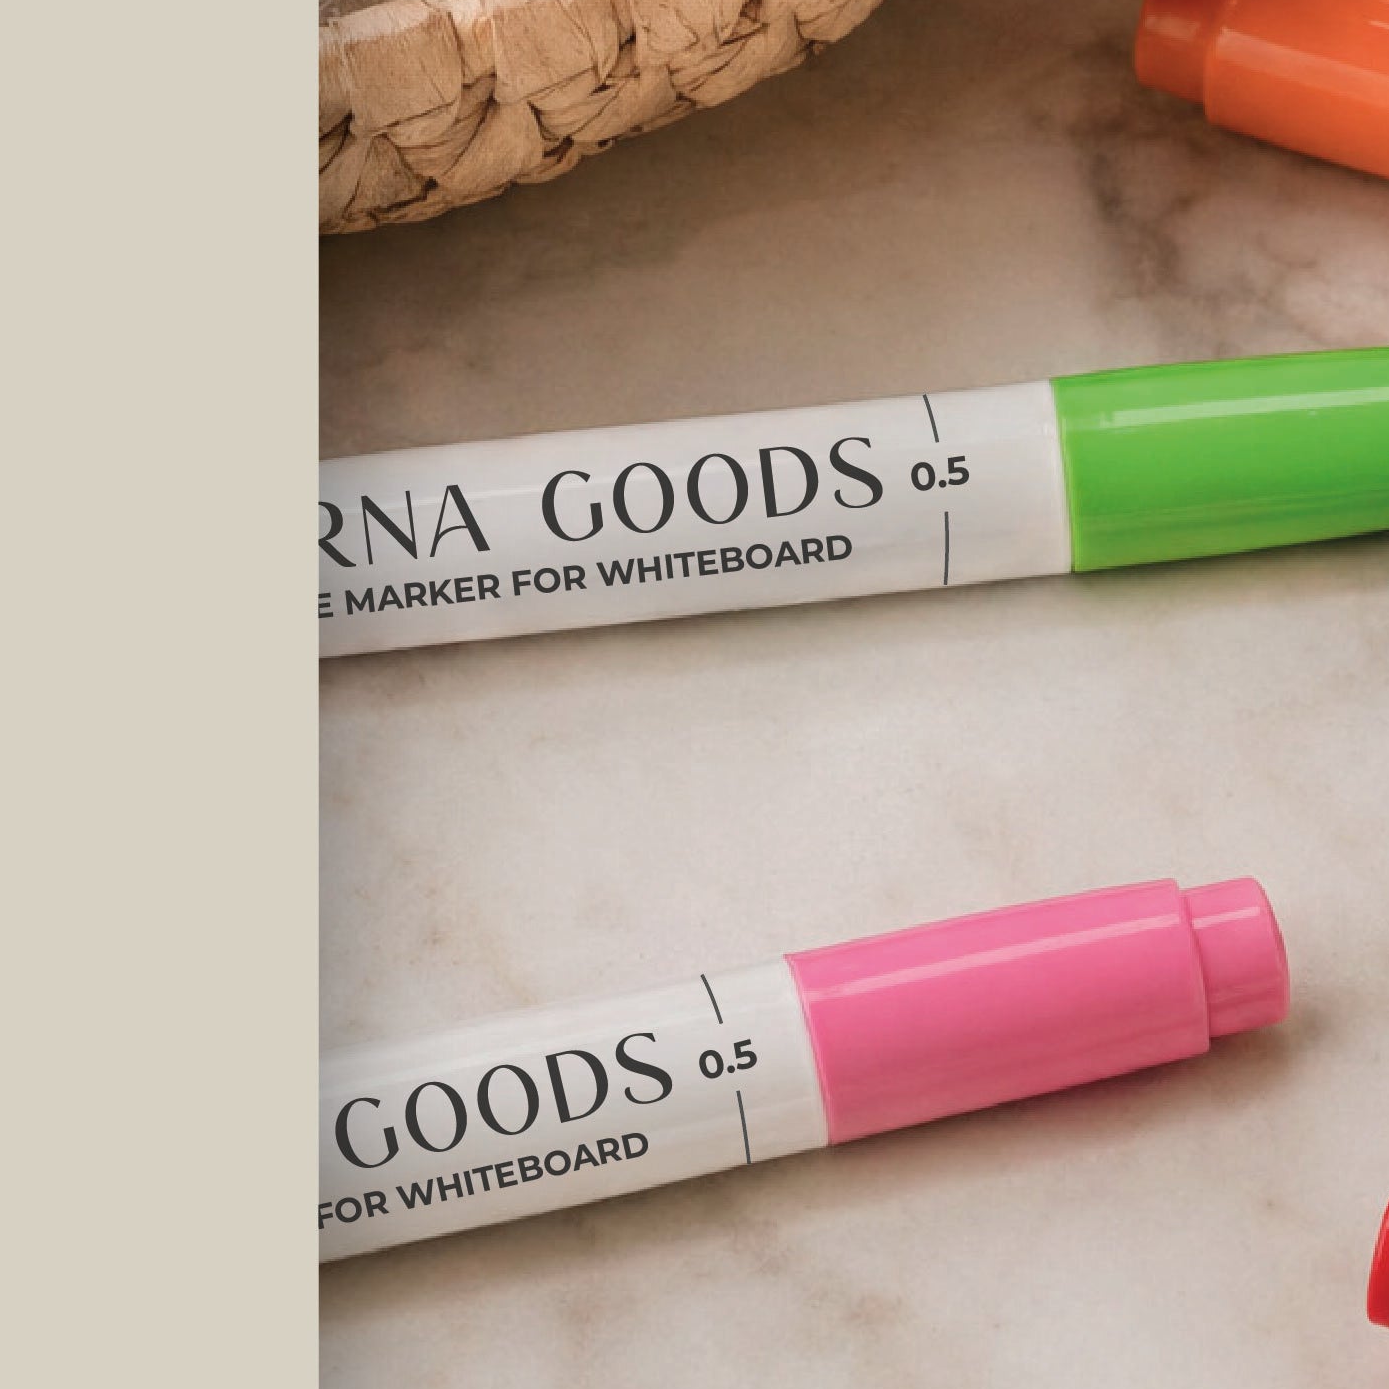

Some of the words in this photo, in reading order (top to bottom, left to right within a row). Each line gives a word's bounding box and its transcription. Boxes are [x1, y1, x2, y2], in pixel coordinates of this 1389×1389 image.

[542, 437, 883, 541] GOODS
[911, 456, 969, 491] 0.5
[345, 574, 501, 615] MARKER
[512, 565, 587, 596] FOR
[596, 535, 852, 586] WHITEBOARD
[335, 1033, 672, 1168] GOODS
[699, 1039, 757, 1078] 0.5
[319, 1191, 389, 1229] FOR
[396, 1133, 648, 1209] WHITEBOARD
